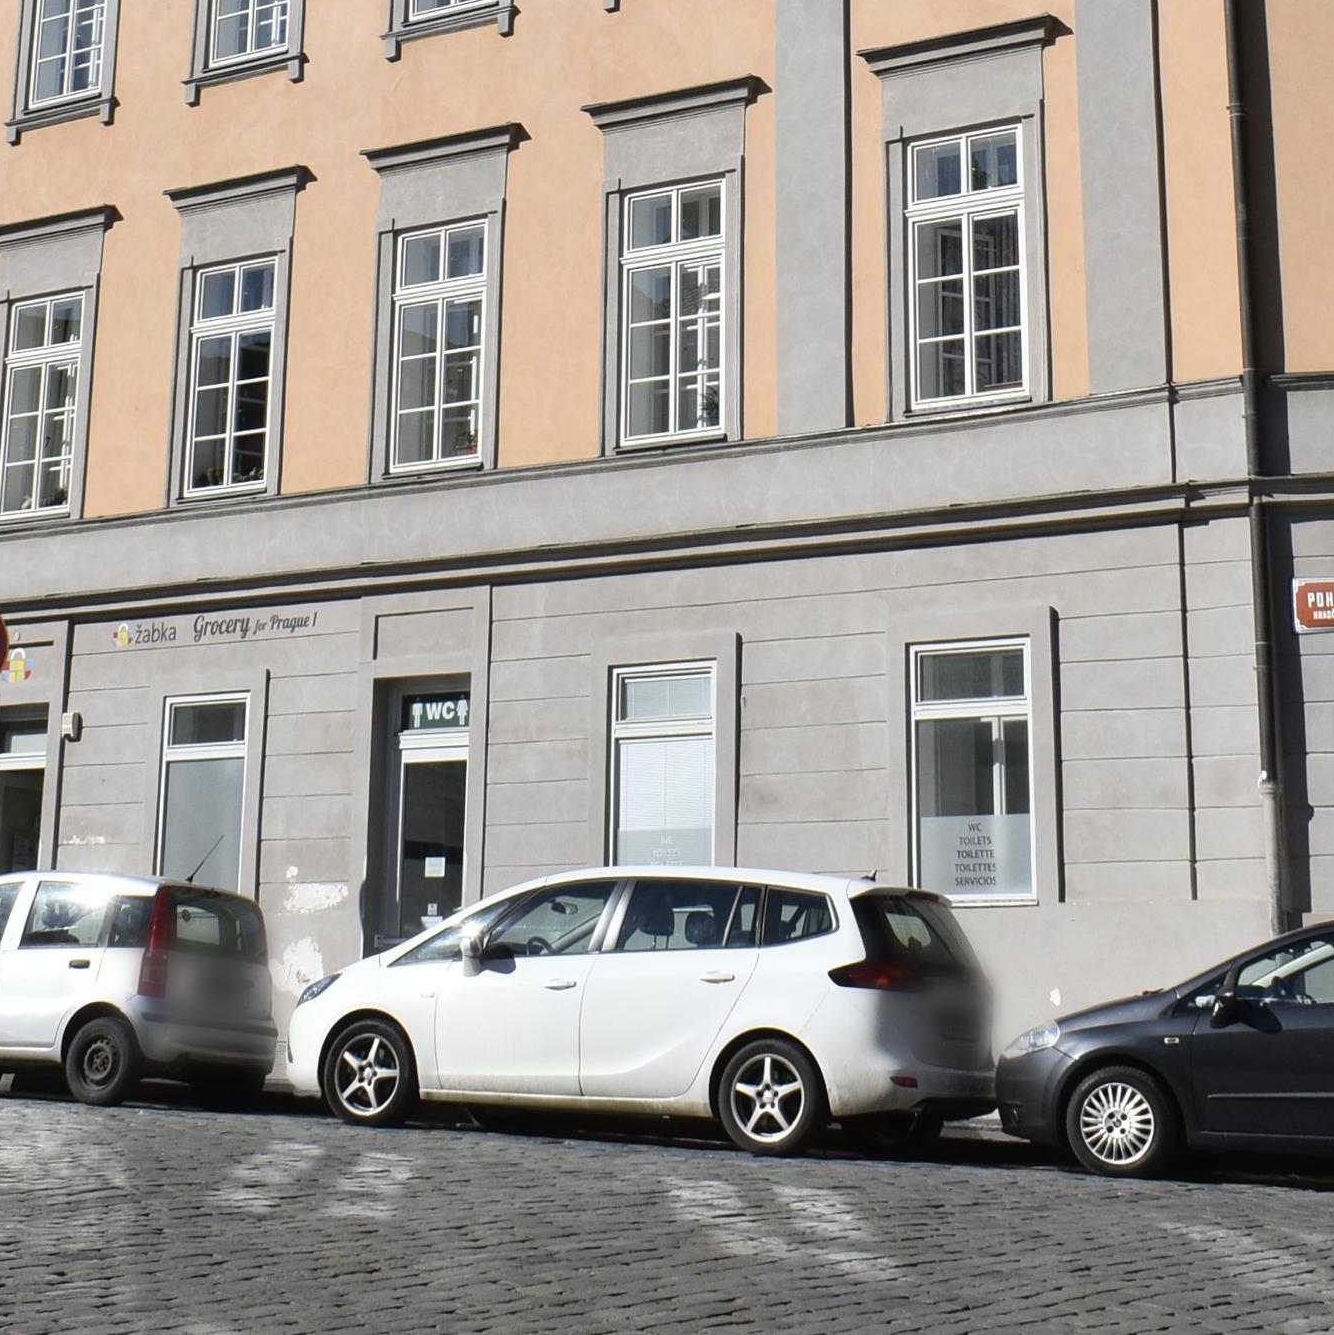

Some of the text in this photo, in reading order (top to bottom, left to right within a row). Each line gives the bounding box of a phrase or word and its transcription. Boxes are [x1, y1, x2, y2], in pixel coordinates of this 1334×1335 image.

[134, 612, 318, 644] žabka Grocery for Prague 1
[425, 701, 456, 721] WC
[968, 822, 982, 832] WC
[959, 835, 992, 846] TOILETS
[956, 849, 995, 859] TOILETTE
